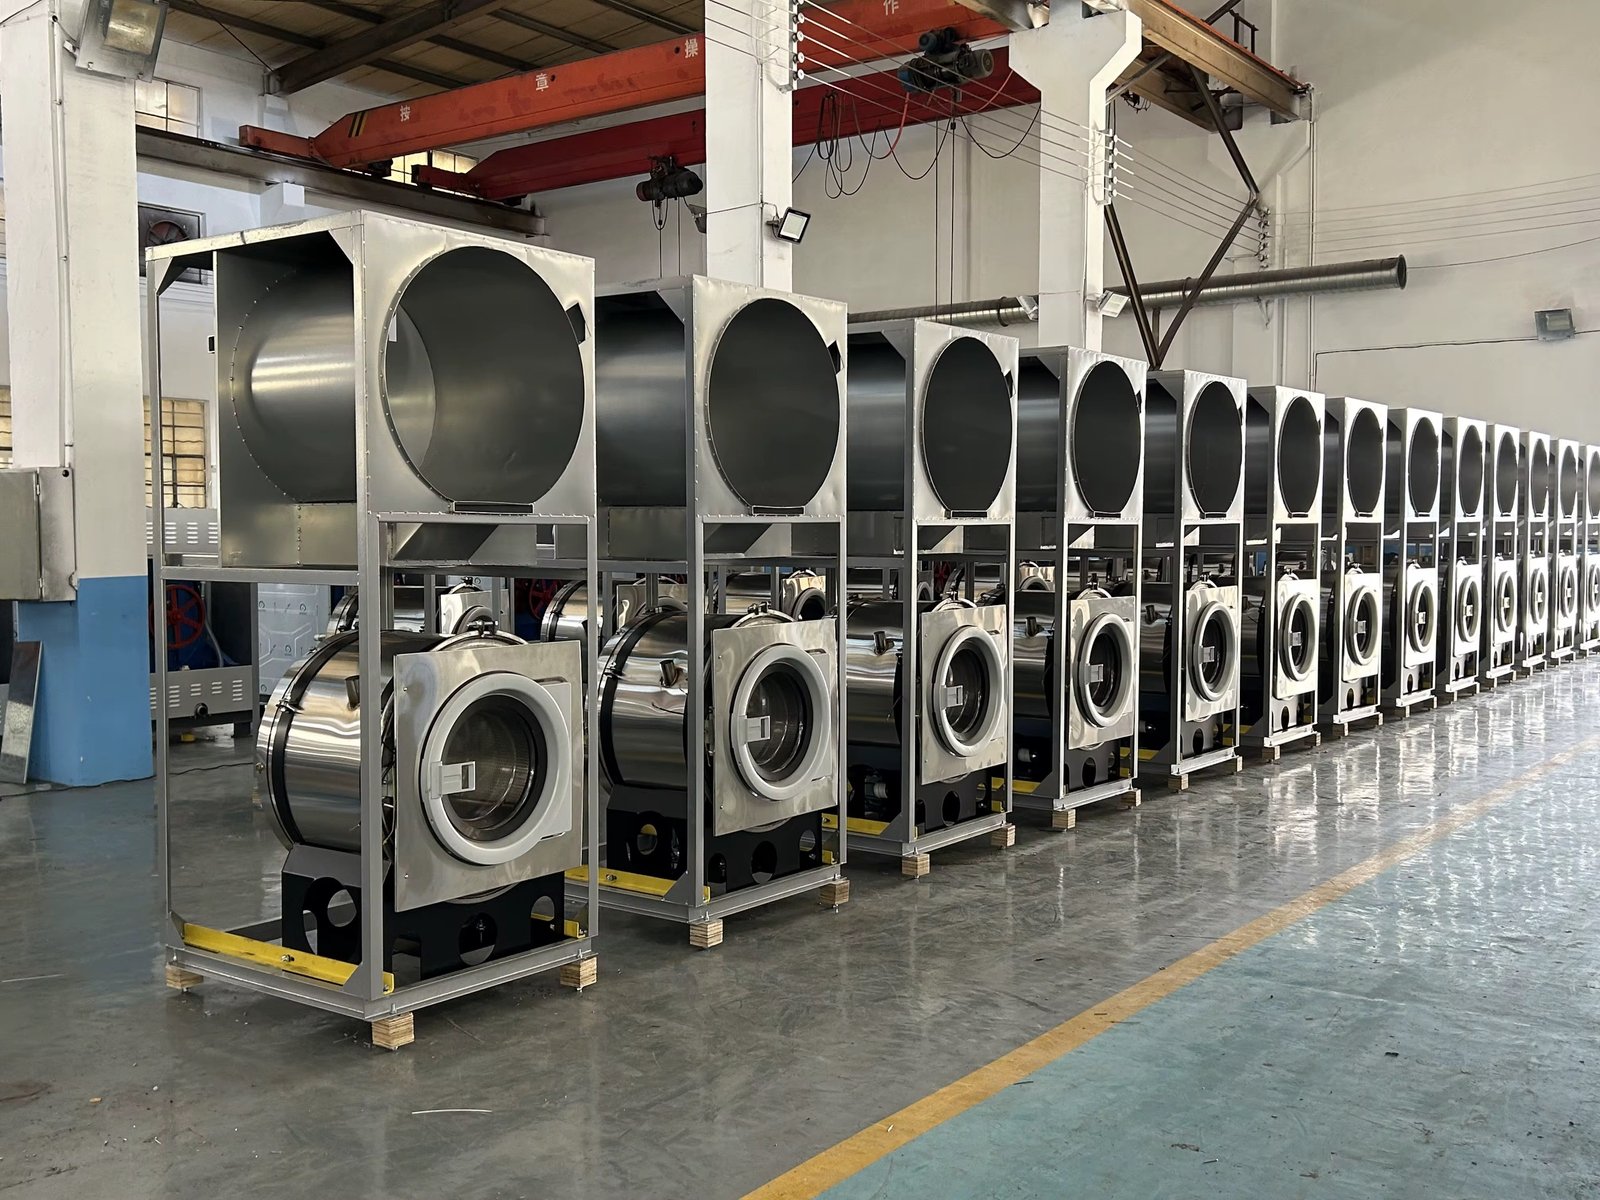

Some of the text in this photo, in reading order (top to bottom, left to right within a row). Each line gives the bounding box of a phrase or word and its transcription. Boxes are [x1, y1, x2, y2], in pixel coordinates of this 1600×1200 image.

[400, 105, 411, 122] 按
[535, 73, 549, 92] 章
[684, 38, 699, 58] 操
